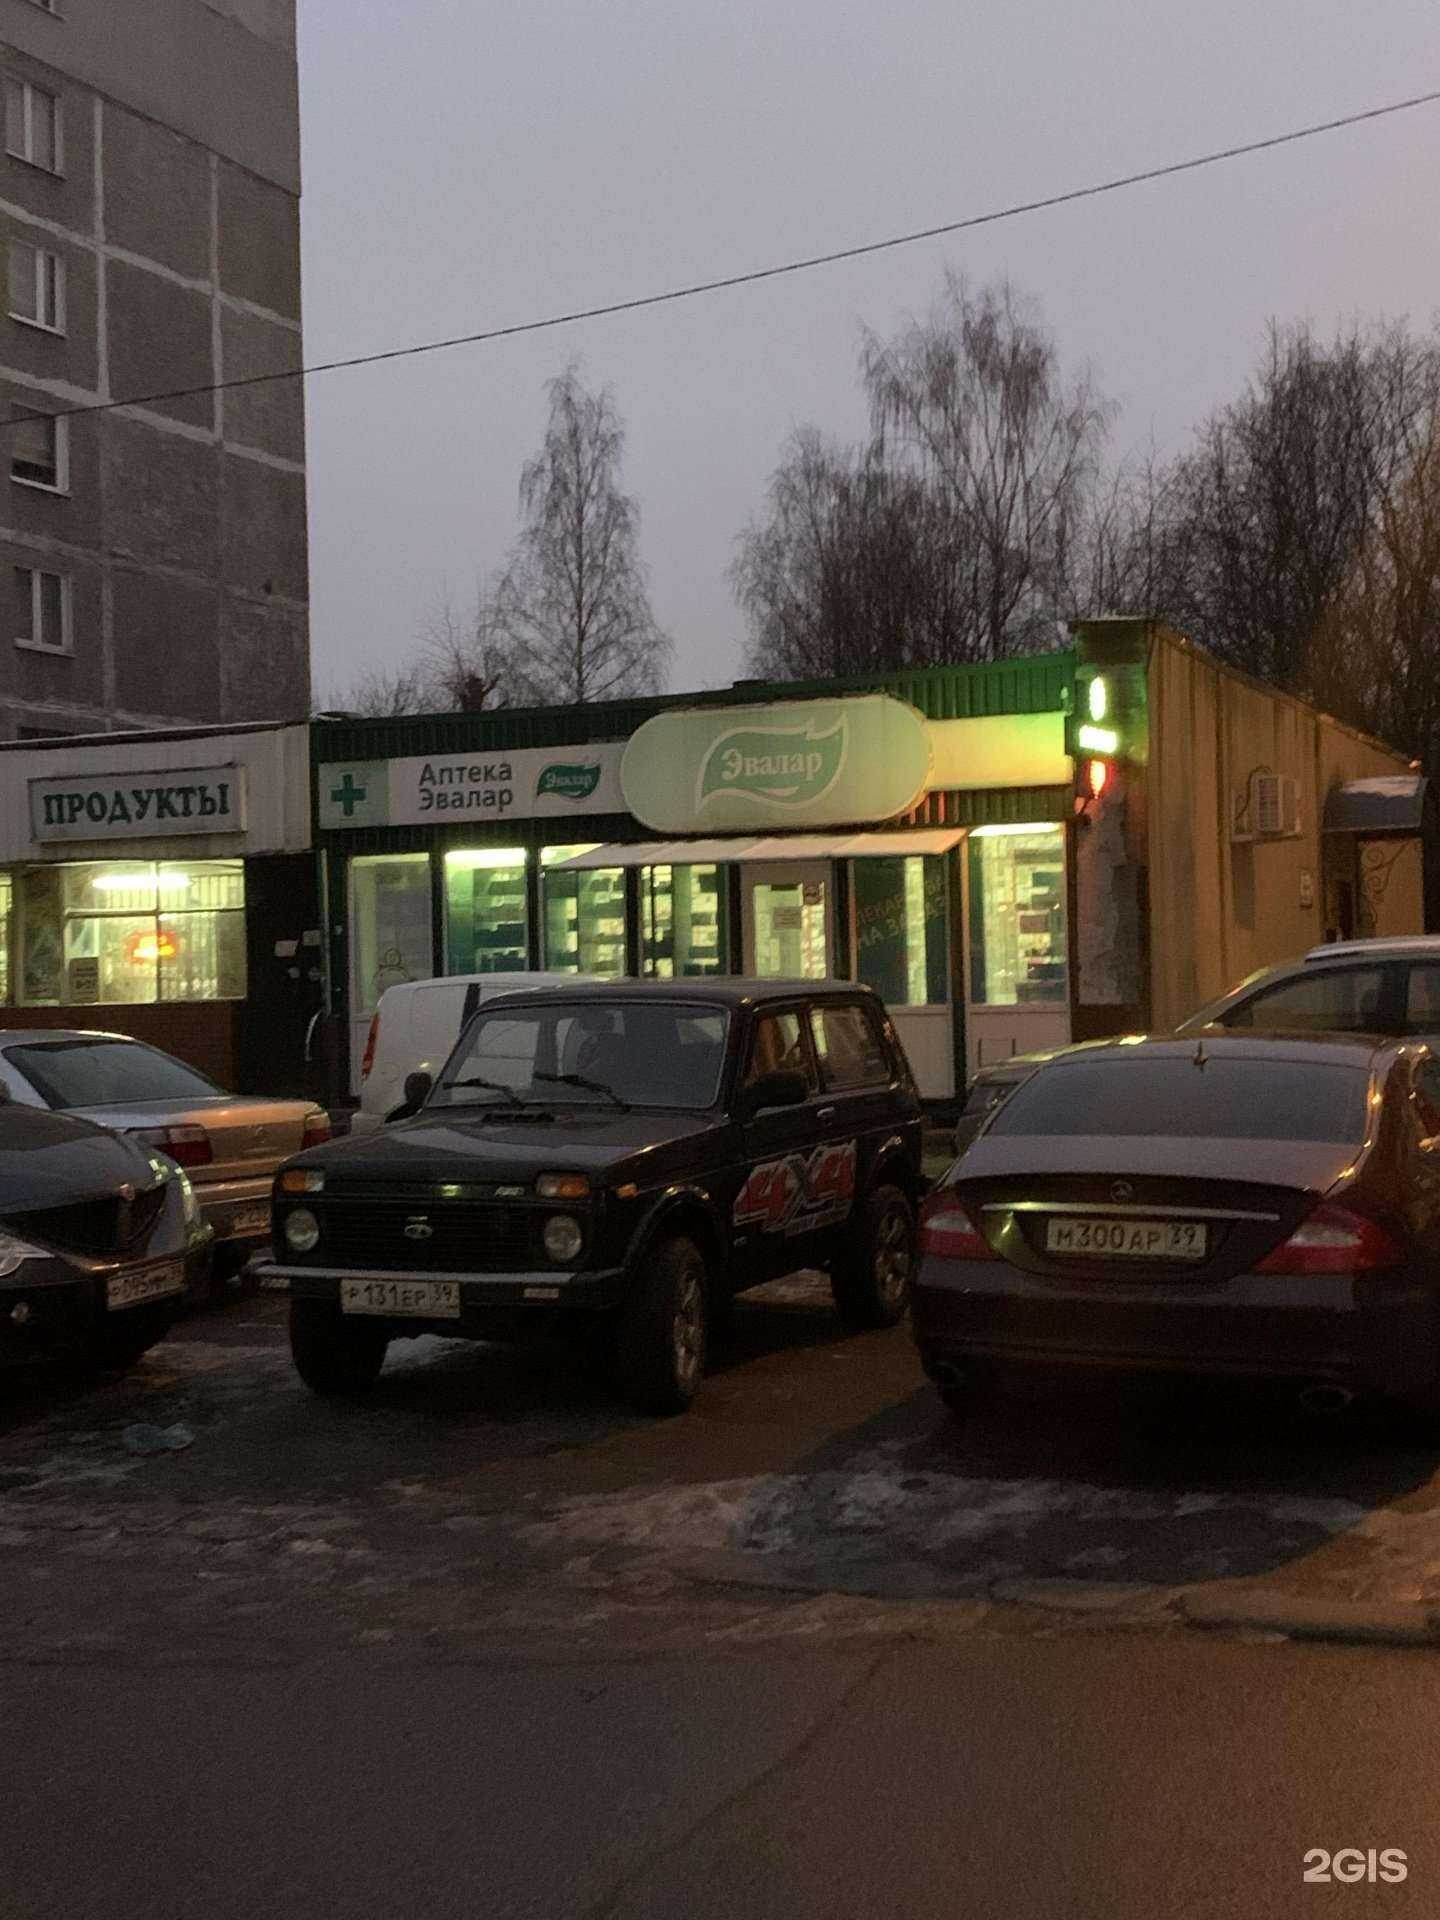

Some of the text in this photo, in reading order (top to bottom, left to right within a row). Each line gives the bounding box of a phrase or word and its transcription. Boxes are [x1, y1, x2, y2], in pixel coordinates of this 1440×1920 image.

[418, 763, 513, 786] Аптека
[721, 748, 823, 781] Эвалар
[42, 783, 230, 825] ПРОДУКТЫ
[418, 788, 513, 812] Эвалар
